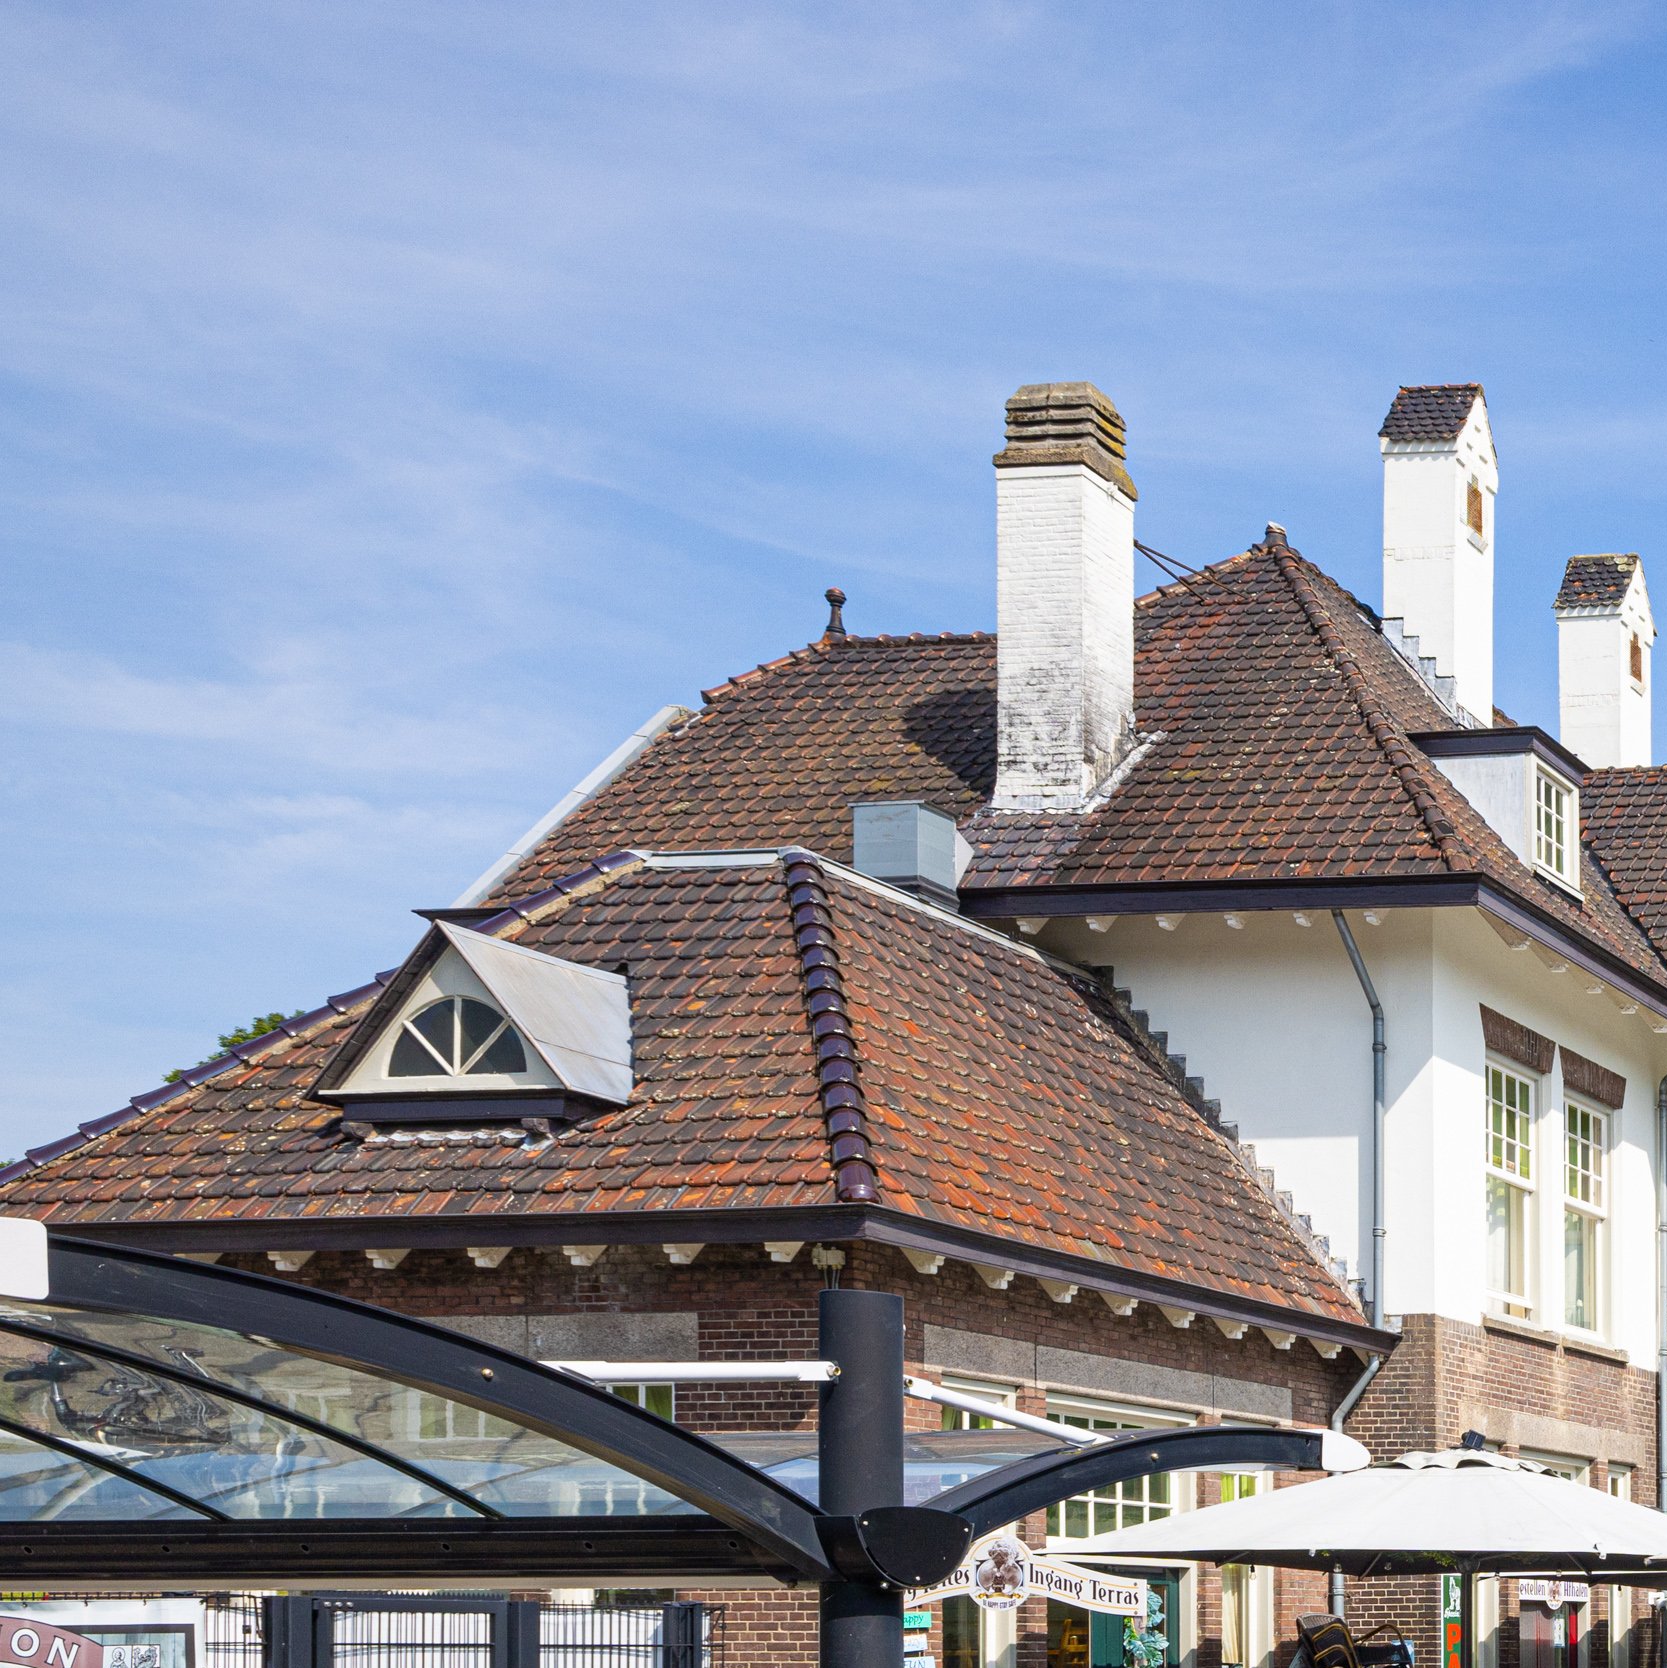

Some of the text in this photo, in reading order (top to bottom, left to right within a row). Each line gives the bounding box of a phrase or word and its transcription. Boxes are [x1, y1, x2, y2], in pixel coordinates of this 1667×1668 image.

[1028, 1562, 1140, 1606] Ingang Terras
[1519, 1579, 1546, 1597] estellen
[903, 1614, 924, 1626] appy
